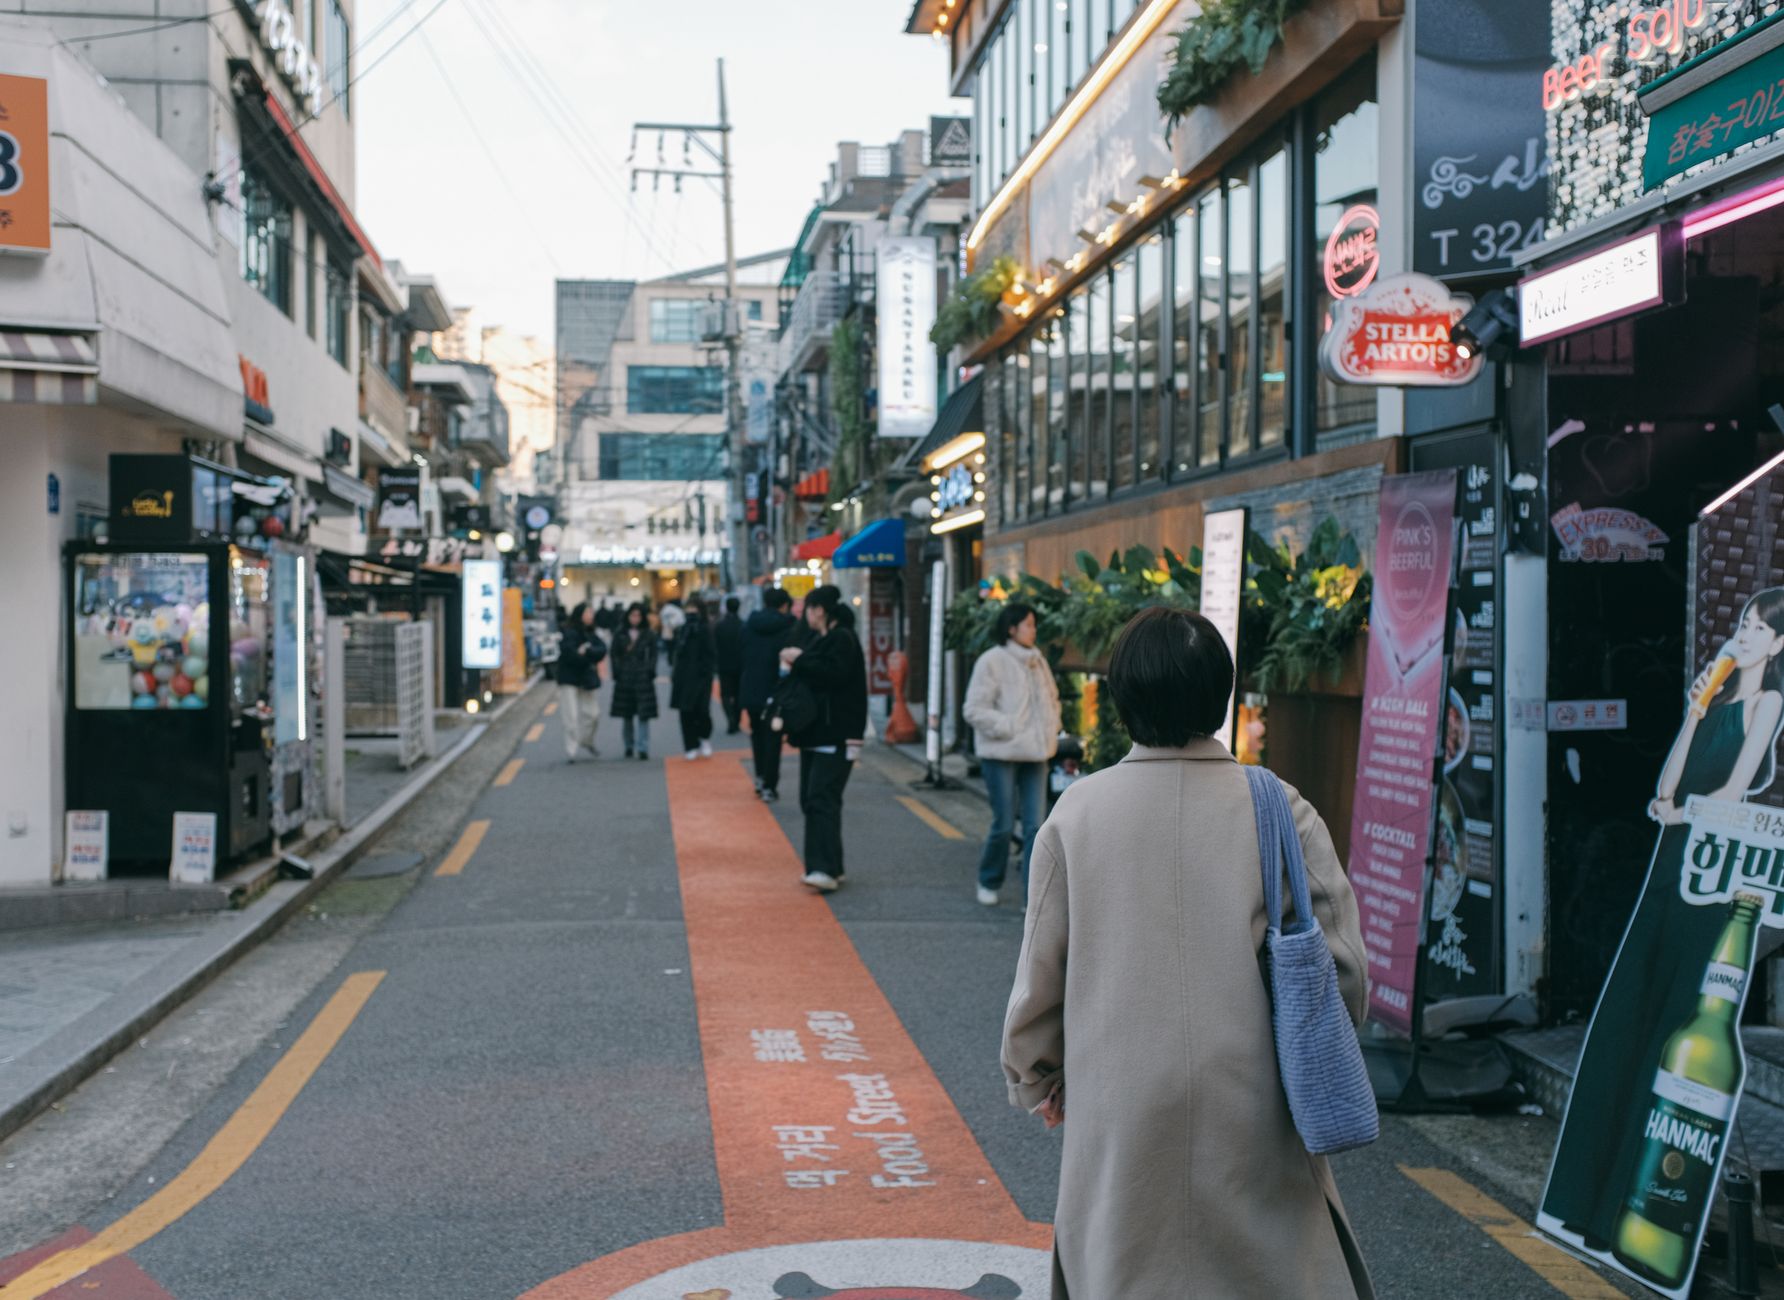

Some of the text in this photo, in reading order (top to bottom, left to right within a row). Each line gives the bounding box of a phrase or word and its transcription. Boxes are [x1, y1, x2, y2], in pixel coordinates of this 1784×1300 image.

[1542, 43, 1611, 111] Beer
[1430, 228, 1459, 266] T
[1366, 322, 1449, 342] STELLA
[1365, 342, 1450, 365] ARTOIS
[1389, 551, 1433, 571] BEERFUL
[1371, 823, 1416, 849] COCKTAIL
[1707, 971, 1744, 994] HANMAC
[834, 1072, 937, 1189] Food Street
[1645, 1107, 1720, 1157] HANMAC
